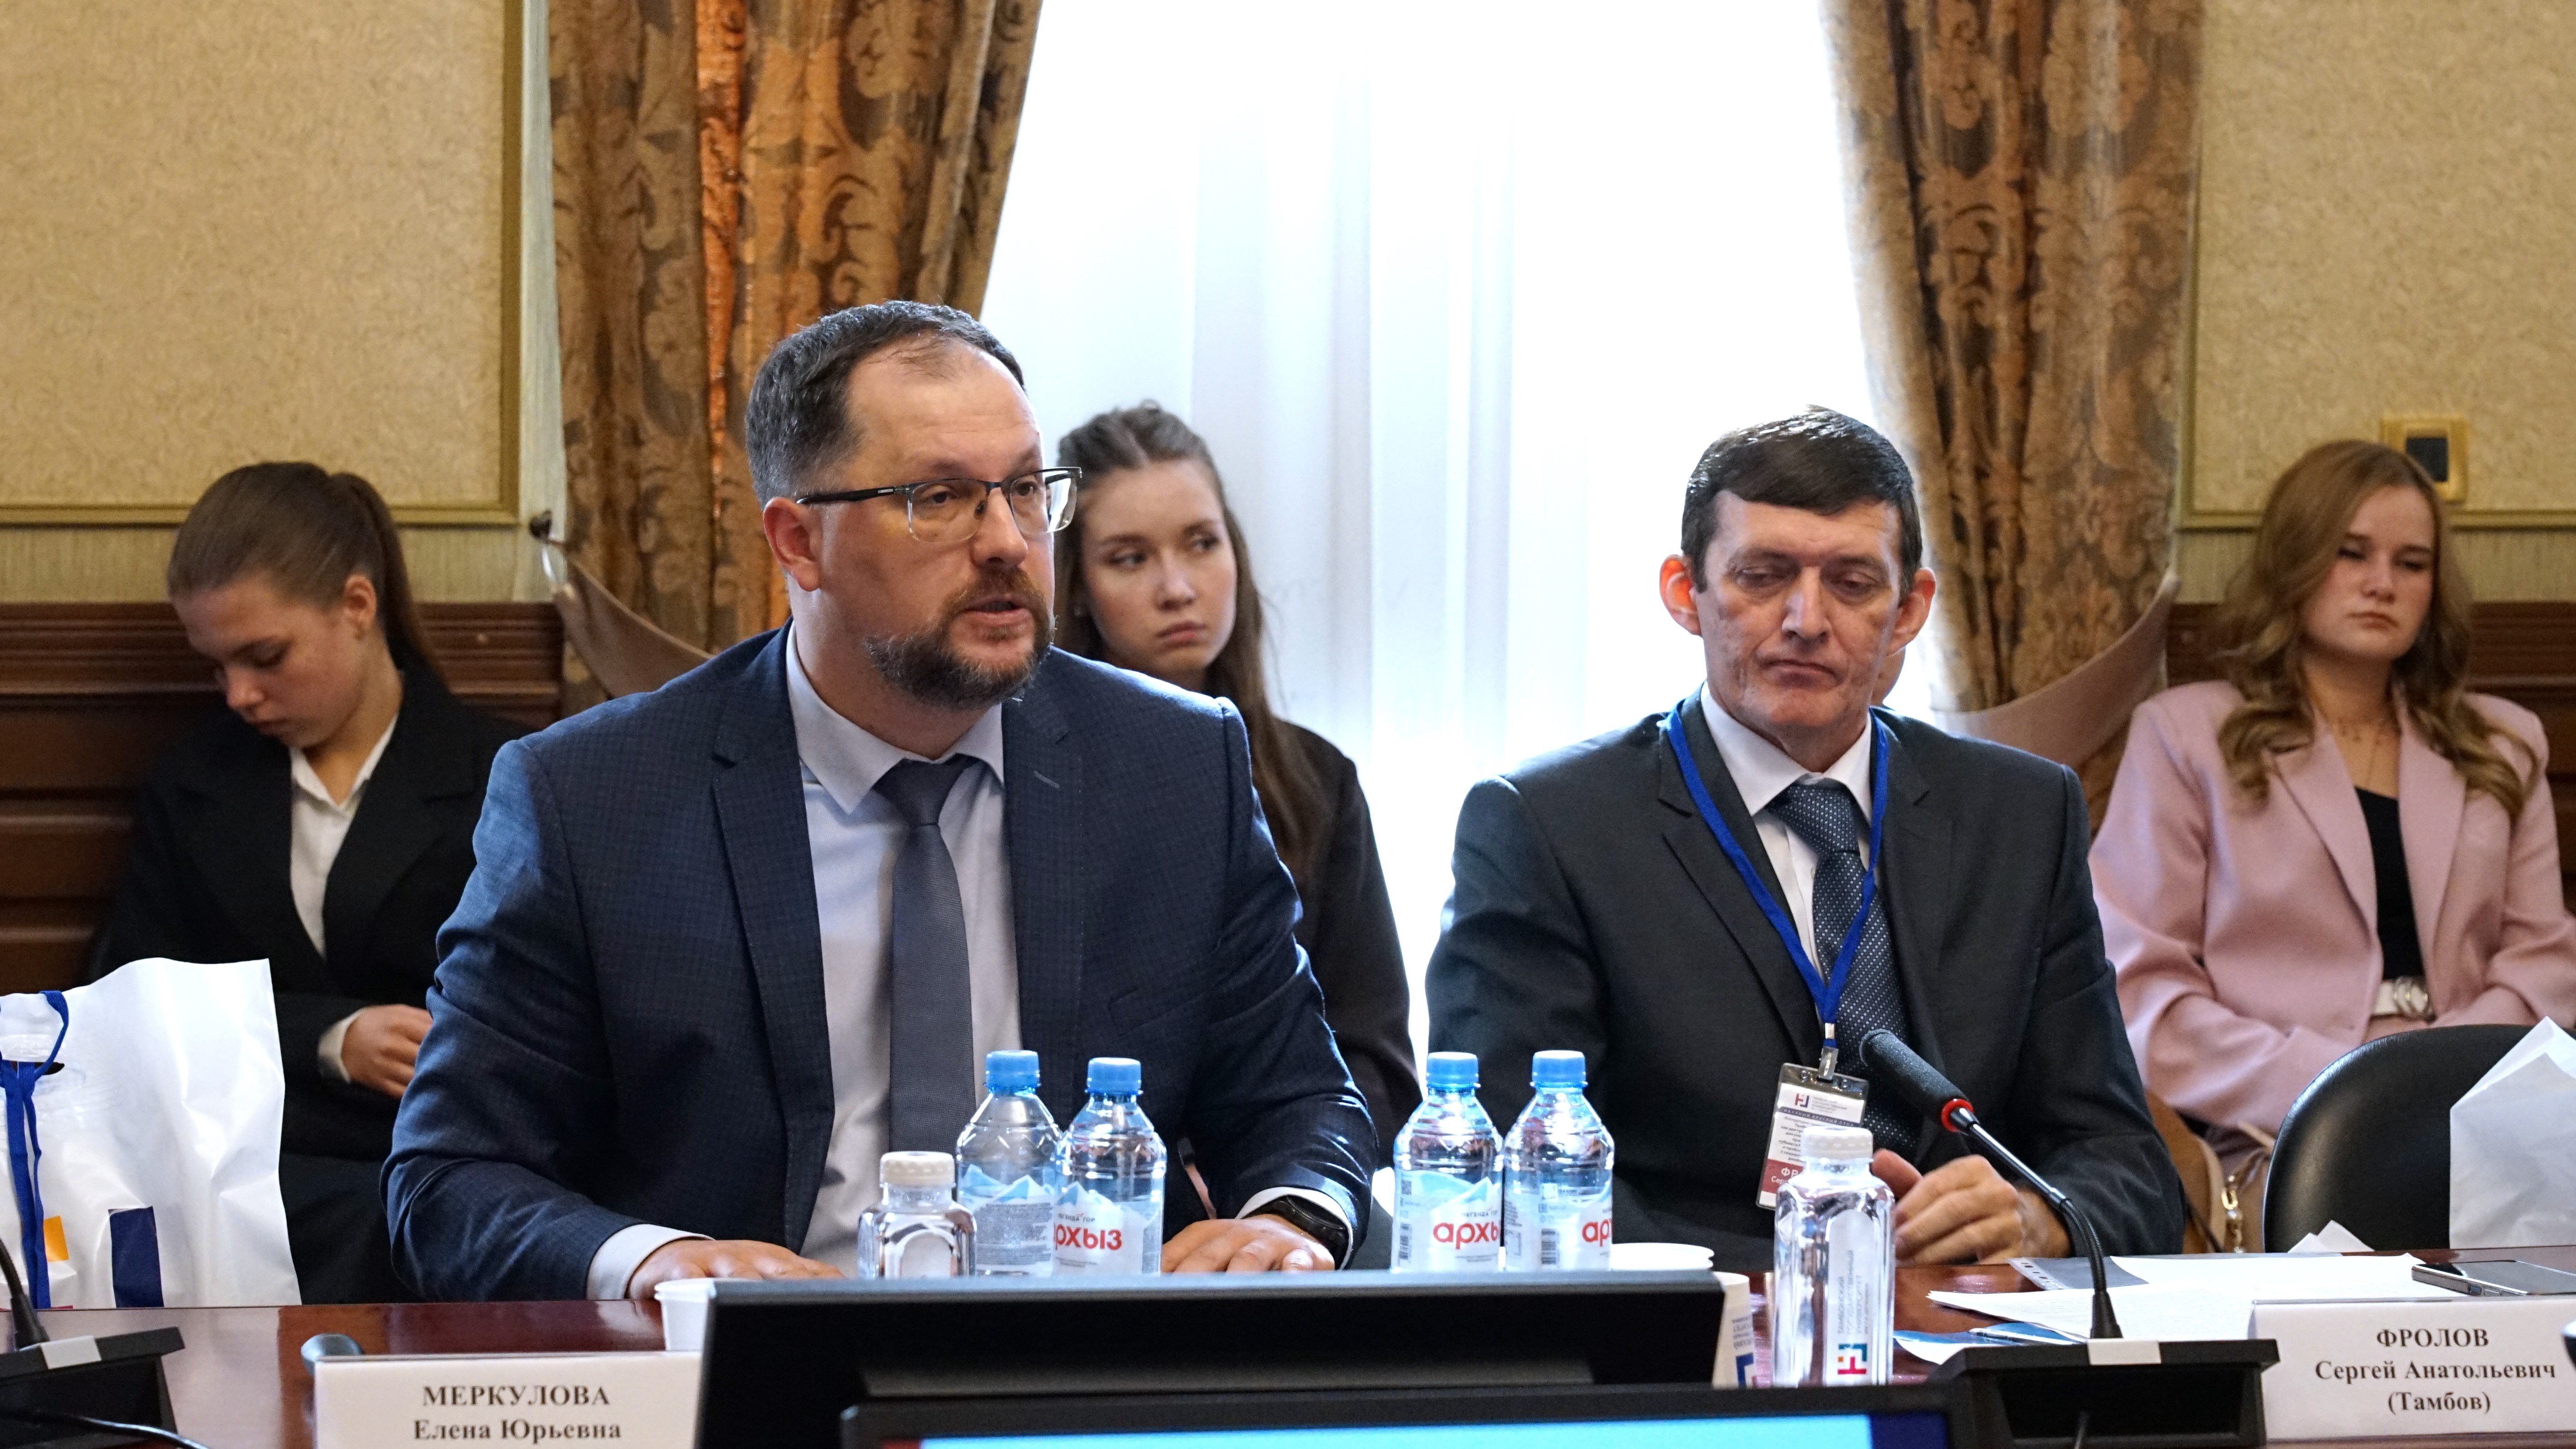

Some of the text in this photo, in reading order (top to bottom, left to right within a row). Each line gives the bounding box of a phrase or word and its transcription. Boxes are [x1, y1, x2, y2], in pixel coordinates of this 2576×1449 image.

[1781, 1167, 1799, 1178] ФР
[1054, 1222, 1122, 1251] рхыз
[1433, 1220, 1500, 1250] архы
[1582, 1218, 1611, 1247] ар
[2376, 1328, 2489, 1348] ФРОЛОВ
[2315, 1360, 2556, 1385] Сергей Анатольевич
[422, 1385, 610, 1407] МЕРКУЛОВА
[2387, 1391, 2491, 1415] (Тамбов)
[413, 1418, 621, 1444] Елена Юрьевна
